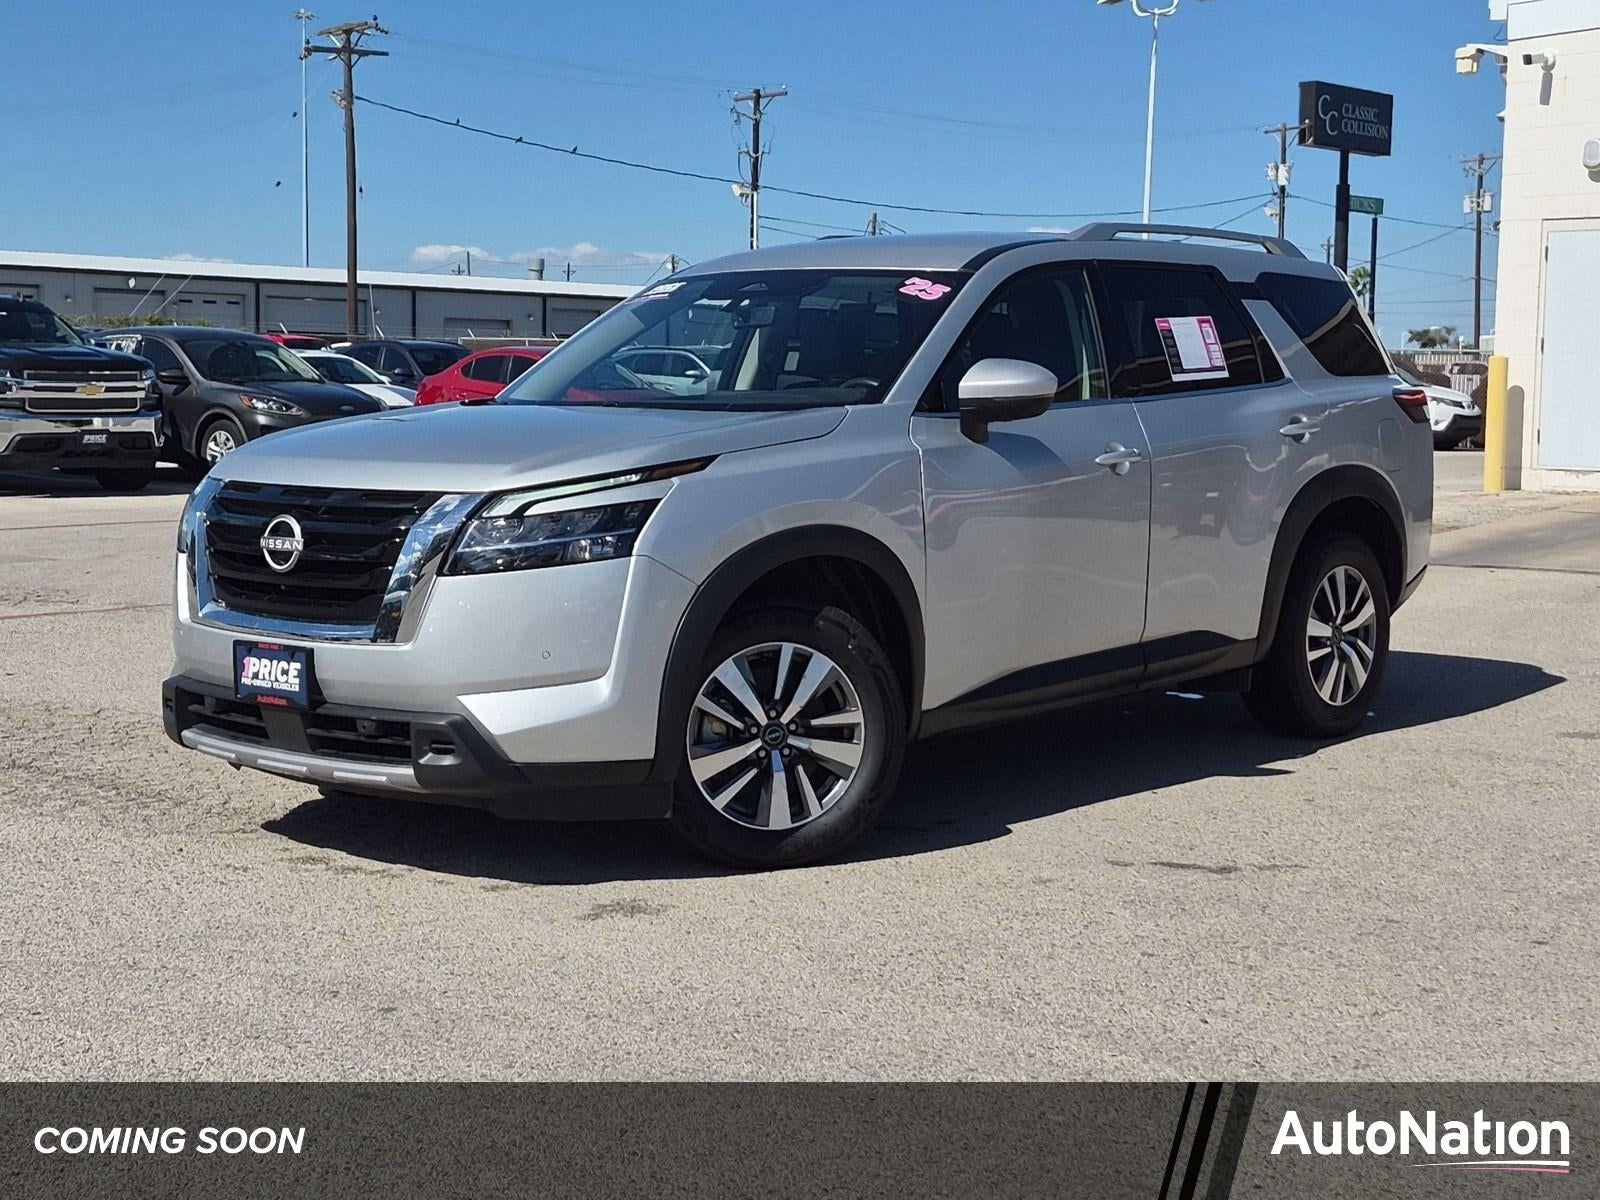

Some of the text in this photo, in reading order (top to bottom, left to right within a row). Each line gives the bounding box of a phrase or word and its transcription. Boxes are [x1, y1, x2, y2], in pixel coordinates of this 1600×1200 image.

[1342, 103, 1379, 122] CLASSIC
[1341, 118, 1388, 139] COLLISION
[899, 276, 952, 300] 25
[260, 538, 303, 551] NISSAN
